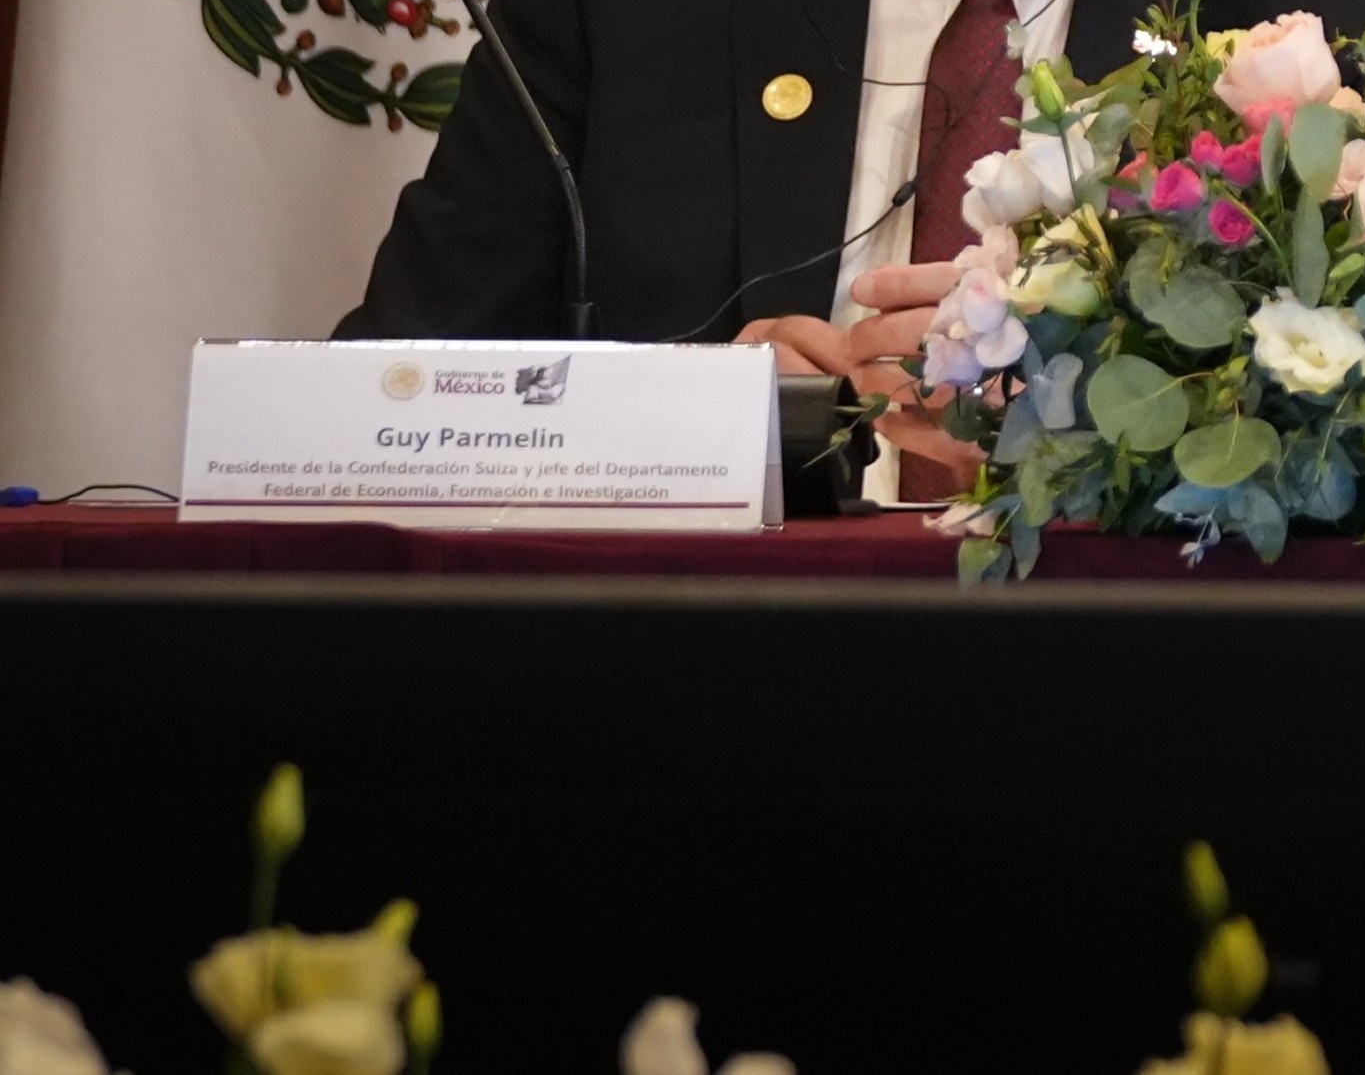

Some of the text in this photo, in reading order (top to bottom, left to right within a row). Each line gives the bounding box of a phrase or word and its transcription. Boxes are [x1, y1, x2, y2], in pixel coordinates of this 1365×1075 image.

[435, 369, 488, 379] Gobierno
[434, 377, 505, 394] México
[376, 427, 565, 453] Guy Parmelin
[208, 460, 729, 478] Presidente de la Confederación Suiza y jefe del Departamento
[264, 483, 669, 501] Federal de Economía, Formación e Investigación
